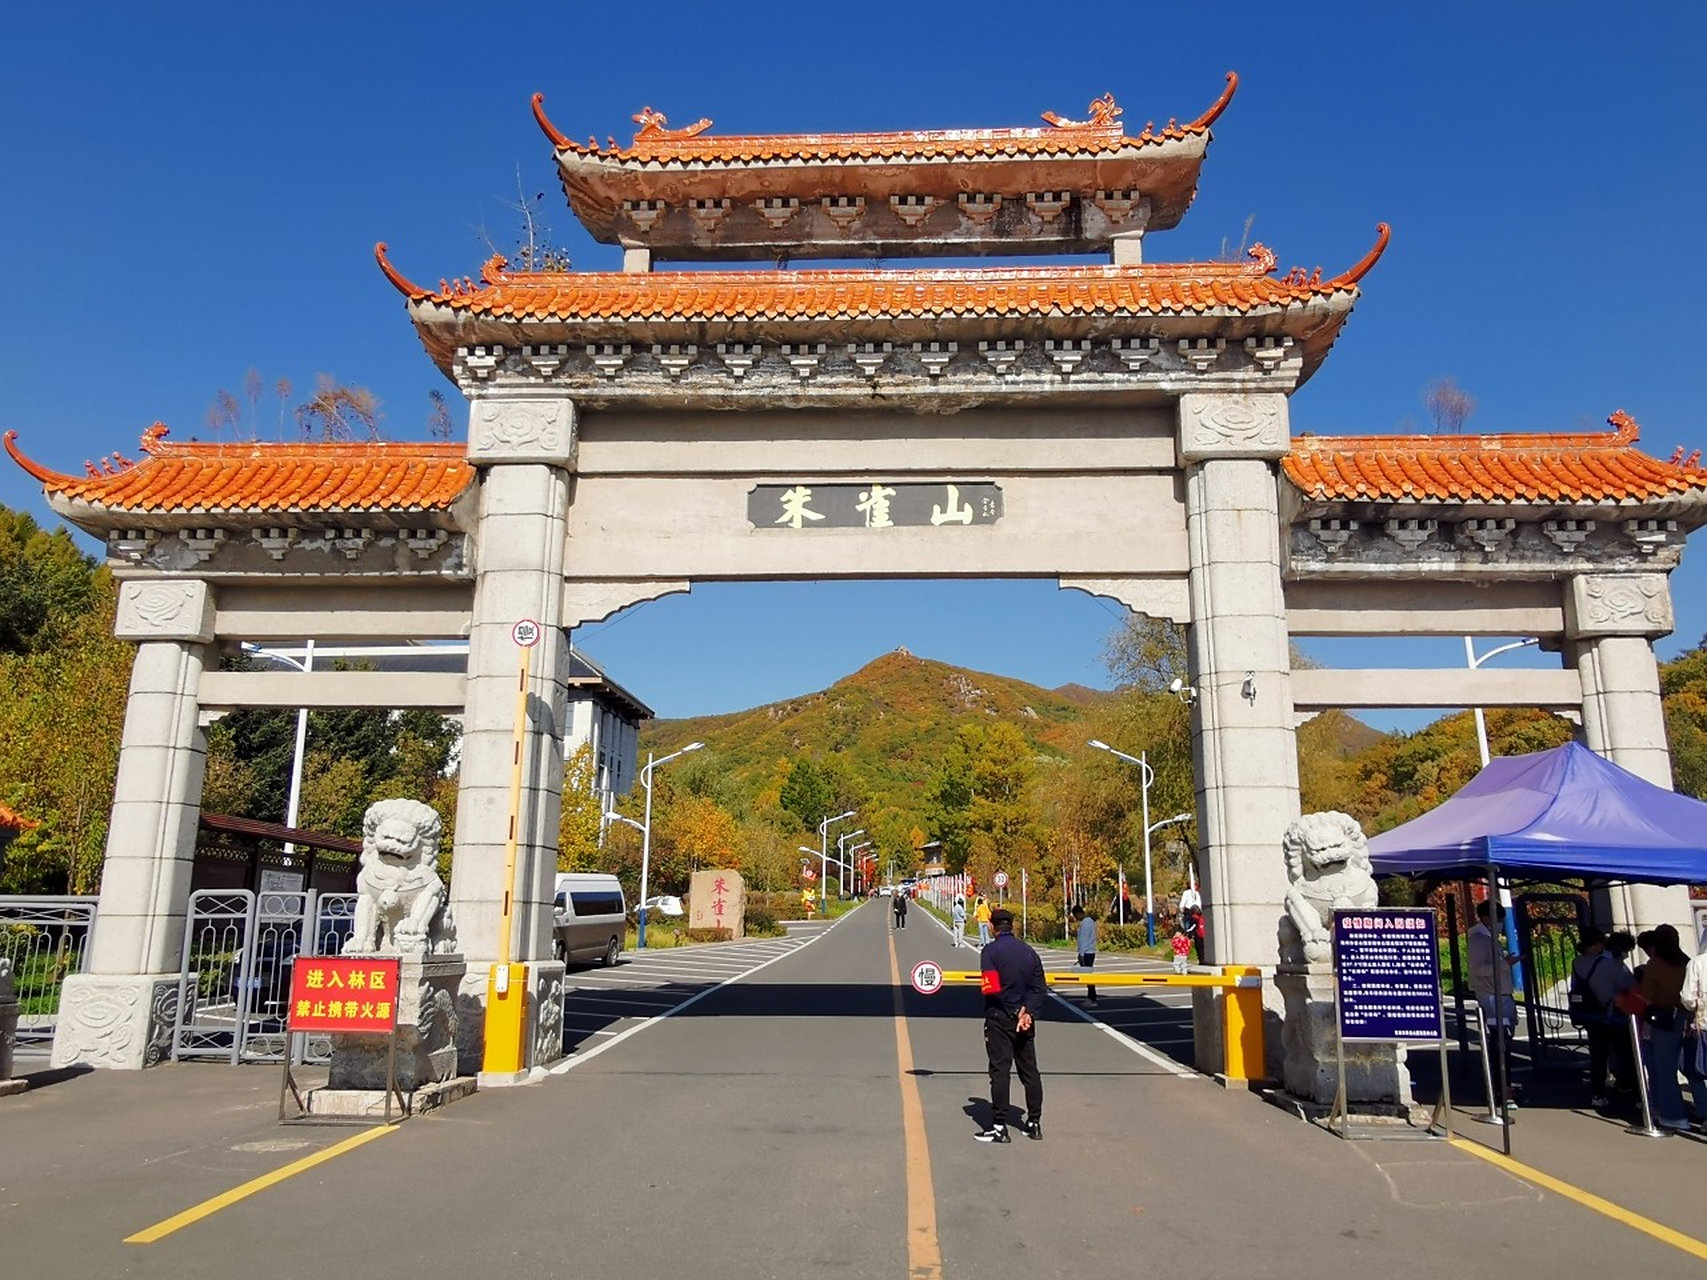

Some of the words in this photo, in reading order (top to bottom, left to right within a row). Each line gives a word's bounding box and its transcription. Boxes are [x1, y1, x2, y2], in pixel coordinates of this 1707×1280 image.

[775, 484, 974, 529] 朱雀山
[306, 969, 386, 990] 进入林区
[918, 967, 936, 987] 慢
[296, 1000, 391, 1019] 禁止携带火源
